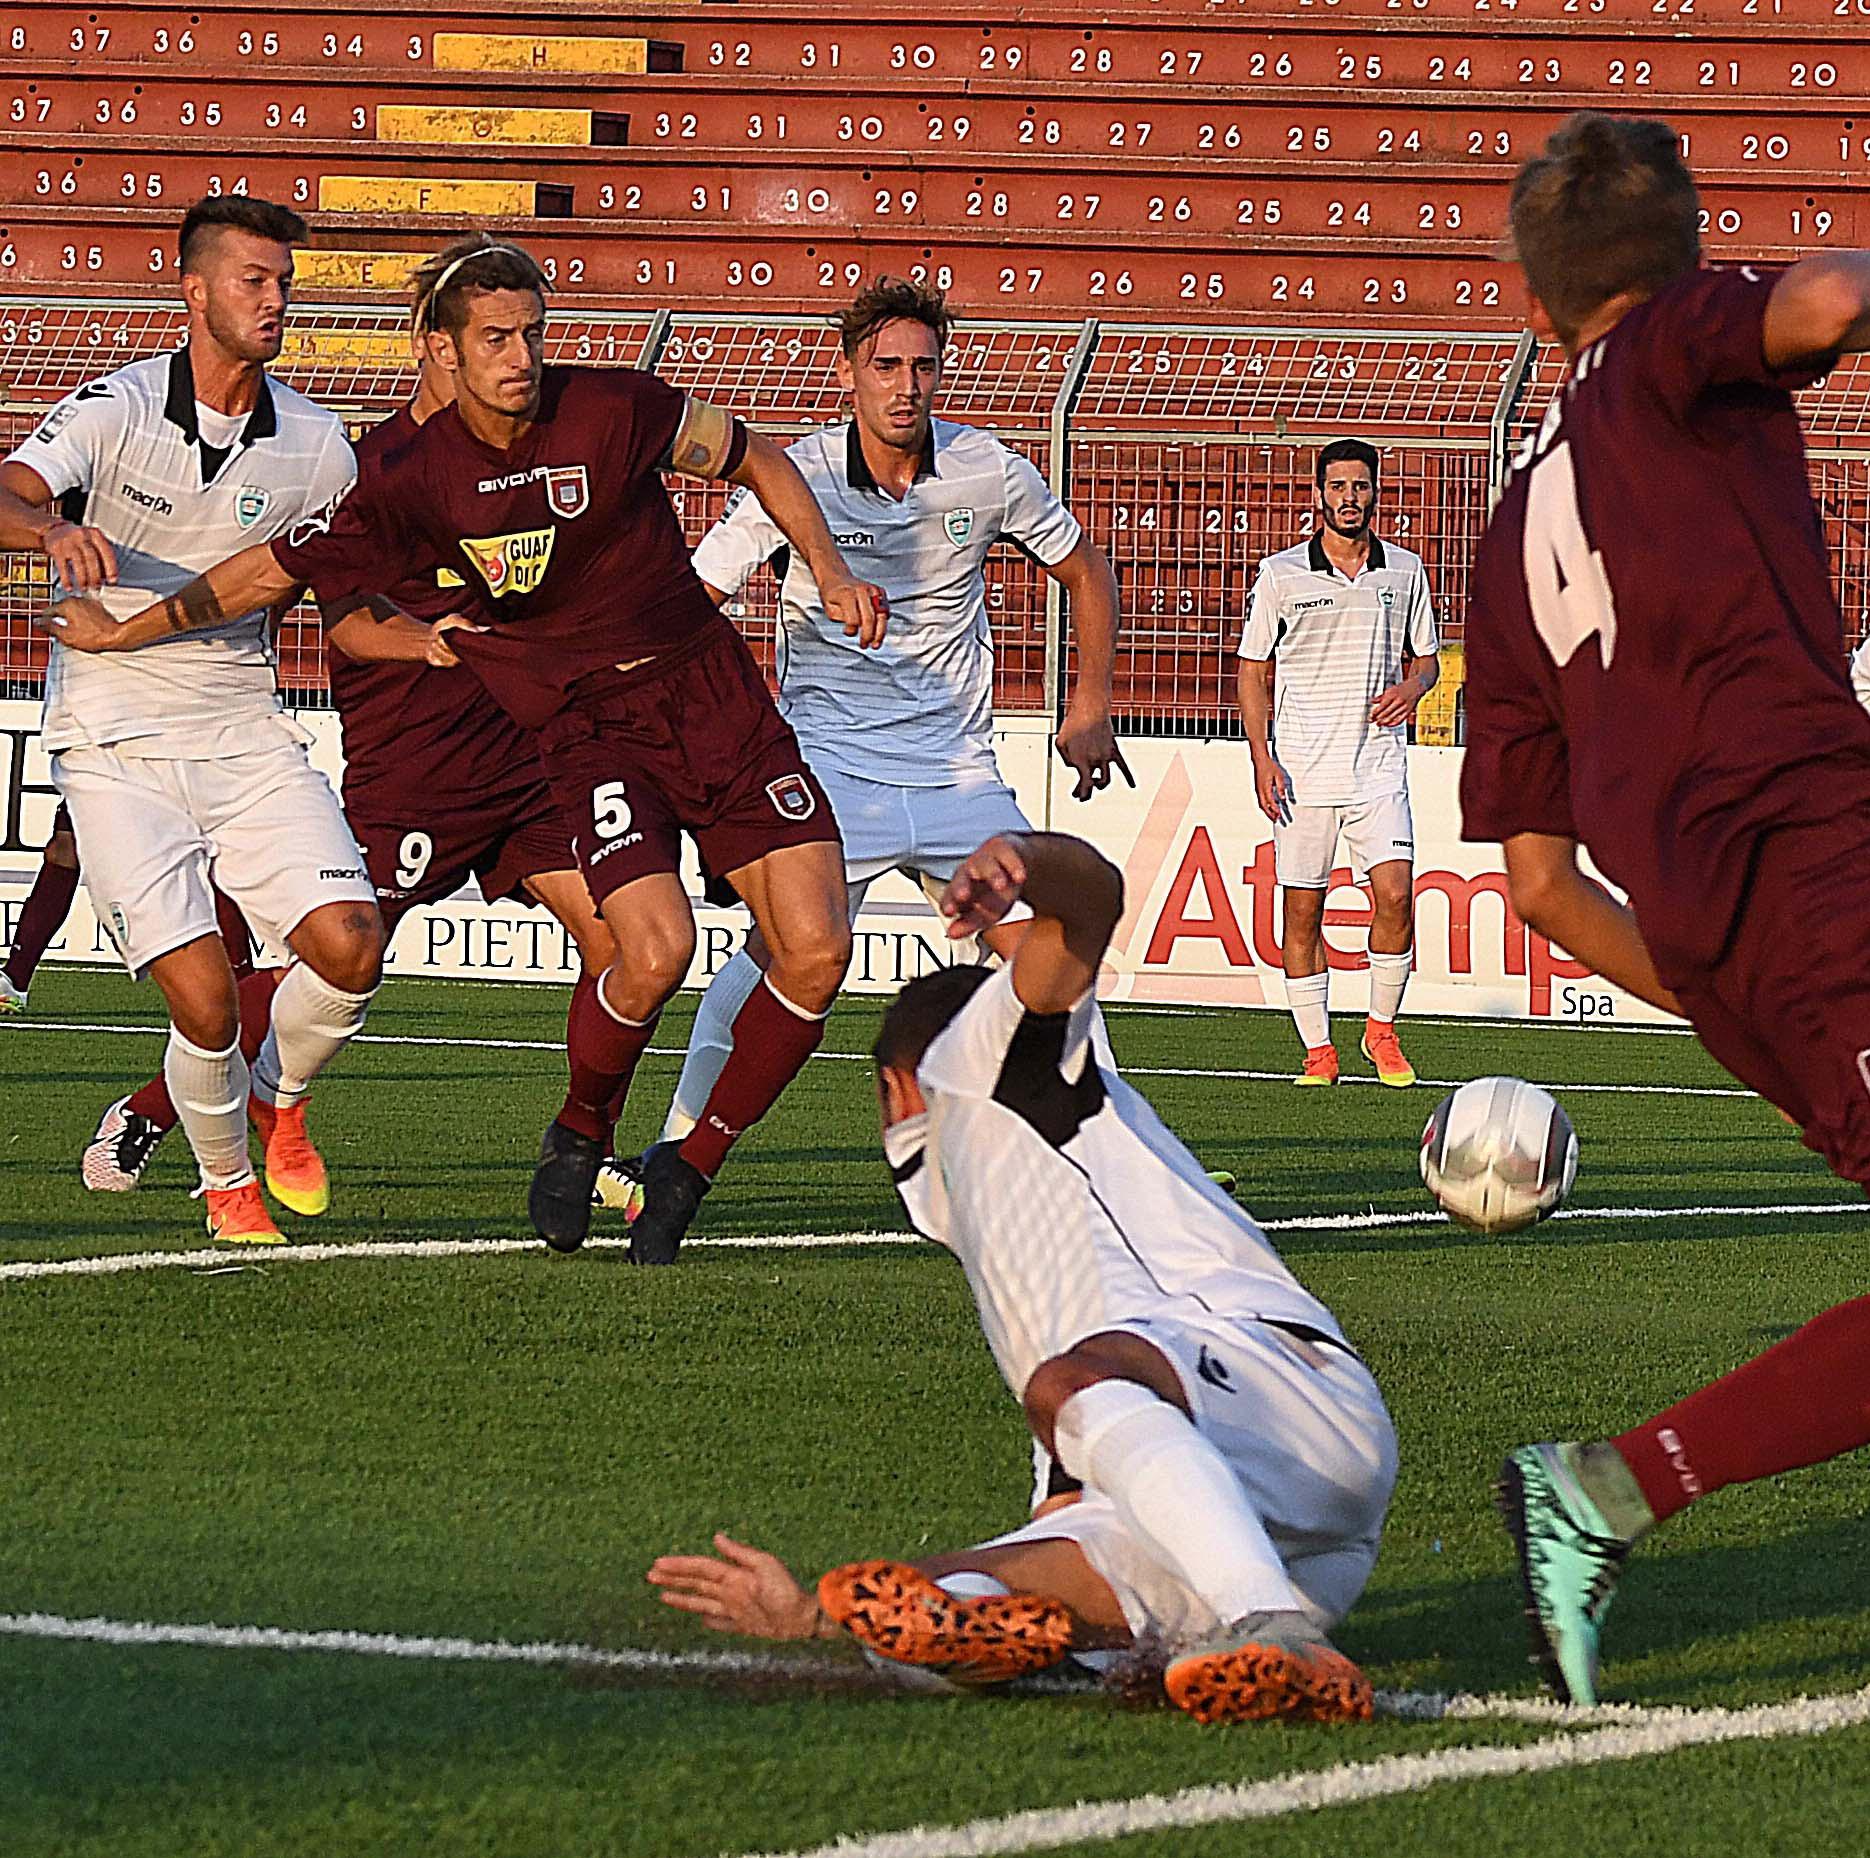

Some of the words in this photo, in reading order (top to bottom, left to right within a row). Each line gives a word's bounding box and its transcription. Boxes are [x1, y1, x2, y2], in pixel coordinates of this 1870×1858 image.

[70, 28, 110, 52] 37
[238, 31, 278, 55] 35
[322, 34, 363, 57] 34
[532, 46, 547, 67] H
[801, 44, 839, 67] 31
[890, 45, 935, 69] 30
[1070, 48, 1111, 72] 28
[1160, 51, 1202, 75] 27
[1339, 56, 1382, 79] 25
[1429, 57, 1471, 81] 24
[1609, 60, 1651, 85] 22
[1699, 62, 1738, 85] 21
[95, 99, 136, 123] 36
[180, 102, 221, 126] 35
[655, 113, 697, 138] 32
[747, 115, 785, 139] 31
[928, 117, 970, 141] 29
[1018, 120, 1060, 144] 28
[1198, 125, 1241, 148] 26
[1287, 127, 1330, 151] 25
[1468, 131, 1510, 155] 23
[1742, 135, 1788, 159] 20
[36, 171, 76, 194] 36
[121, 173, 162, 198] 35
[420, 188, 431, 210] F
[599, 185, 641, 209] 32
[691, 187, 730, 211] 31
[875, 190, 917, 214] 29
[966, 192, 1008, 216] 28
[1148, 197, 1191, 221] 26
[1238, 200, 1281, 224] 25
[1419, 204, 1461, 228] 23
[61, 245, 102, 270] 35
[362, 262, 373, 285] E
[636, 260, 675, 284] 31
[727, 261, 773, 286] 30
[999, 268, 1042, 293] 27
[1180, 274, 1224, 298] 25
[1272, 276, 1315, 301] 24
[1455, 280, 1499, 305] 22
[122, 484, 173, 516] macron
[1523, 440, 1617, 671] 4
[1295, 598, 1334, 611] macron
[592, 782, 632, 839] 5
[395, 831, 433, 889] 9
[1561, 986, 1615, 1023] Spa
